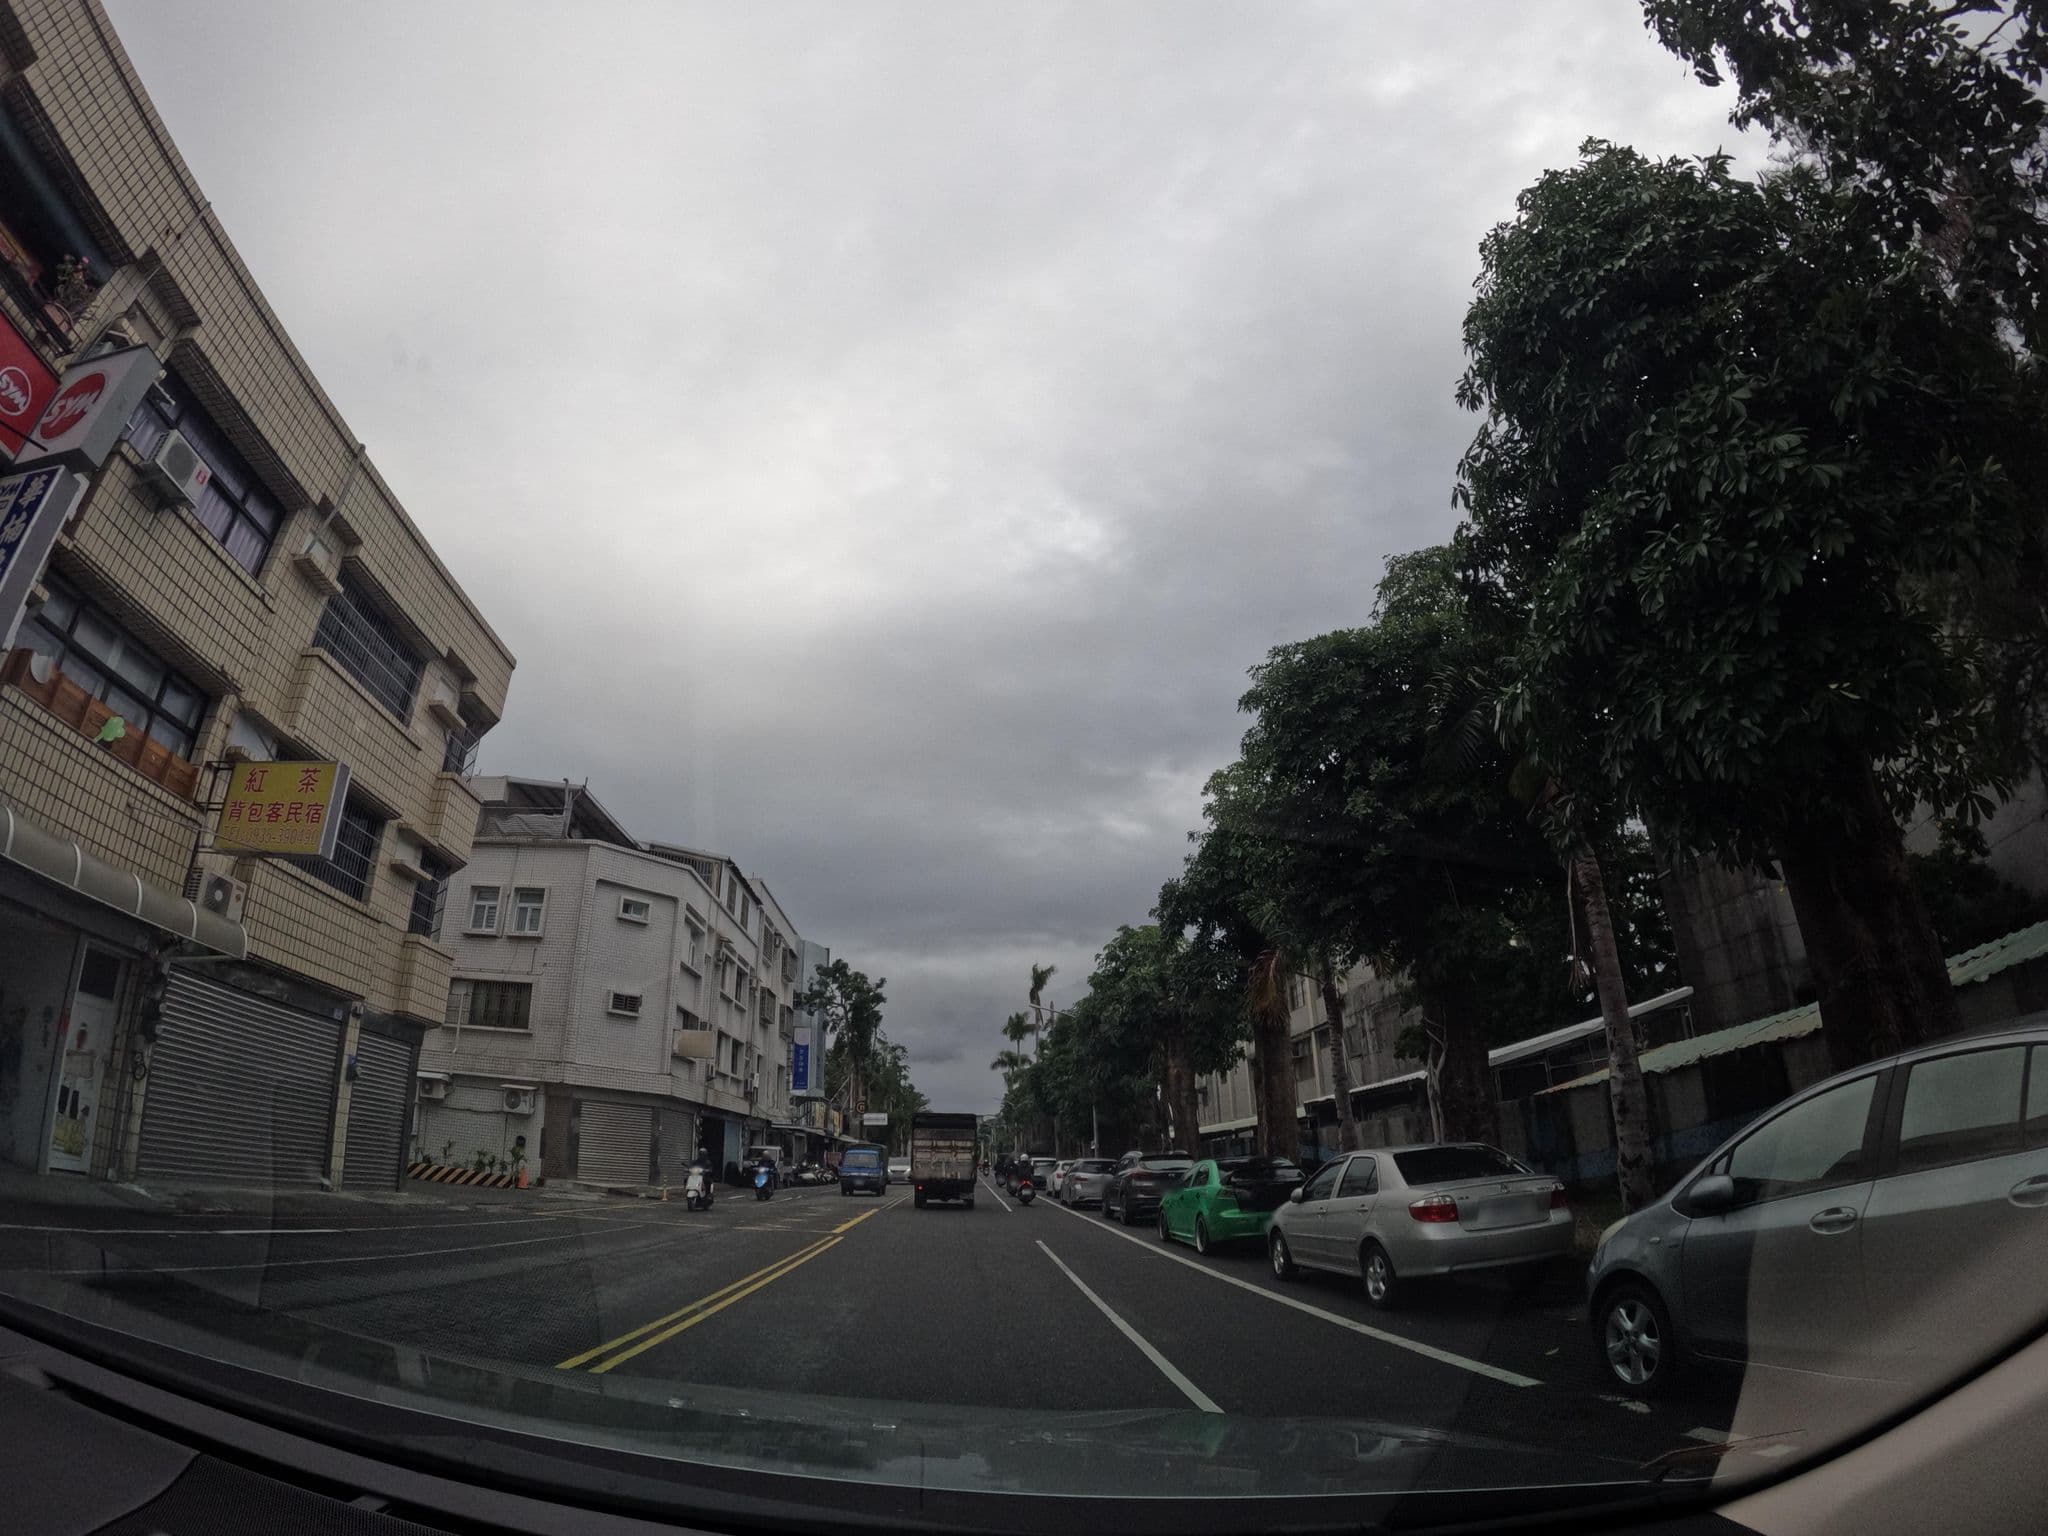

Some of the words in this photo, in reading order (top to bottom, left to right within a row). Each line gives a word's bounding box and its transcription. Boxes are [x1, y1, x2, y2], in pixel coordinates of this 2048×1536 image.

[0, 373, 27, 410] SYM
[40, 388, 100, 427] SYM
[0, 482, 21, 497] YM
[228, 800, 325, 824] 背包客民宿
